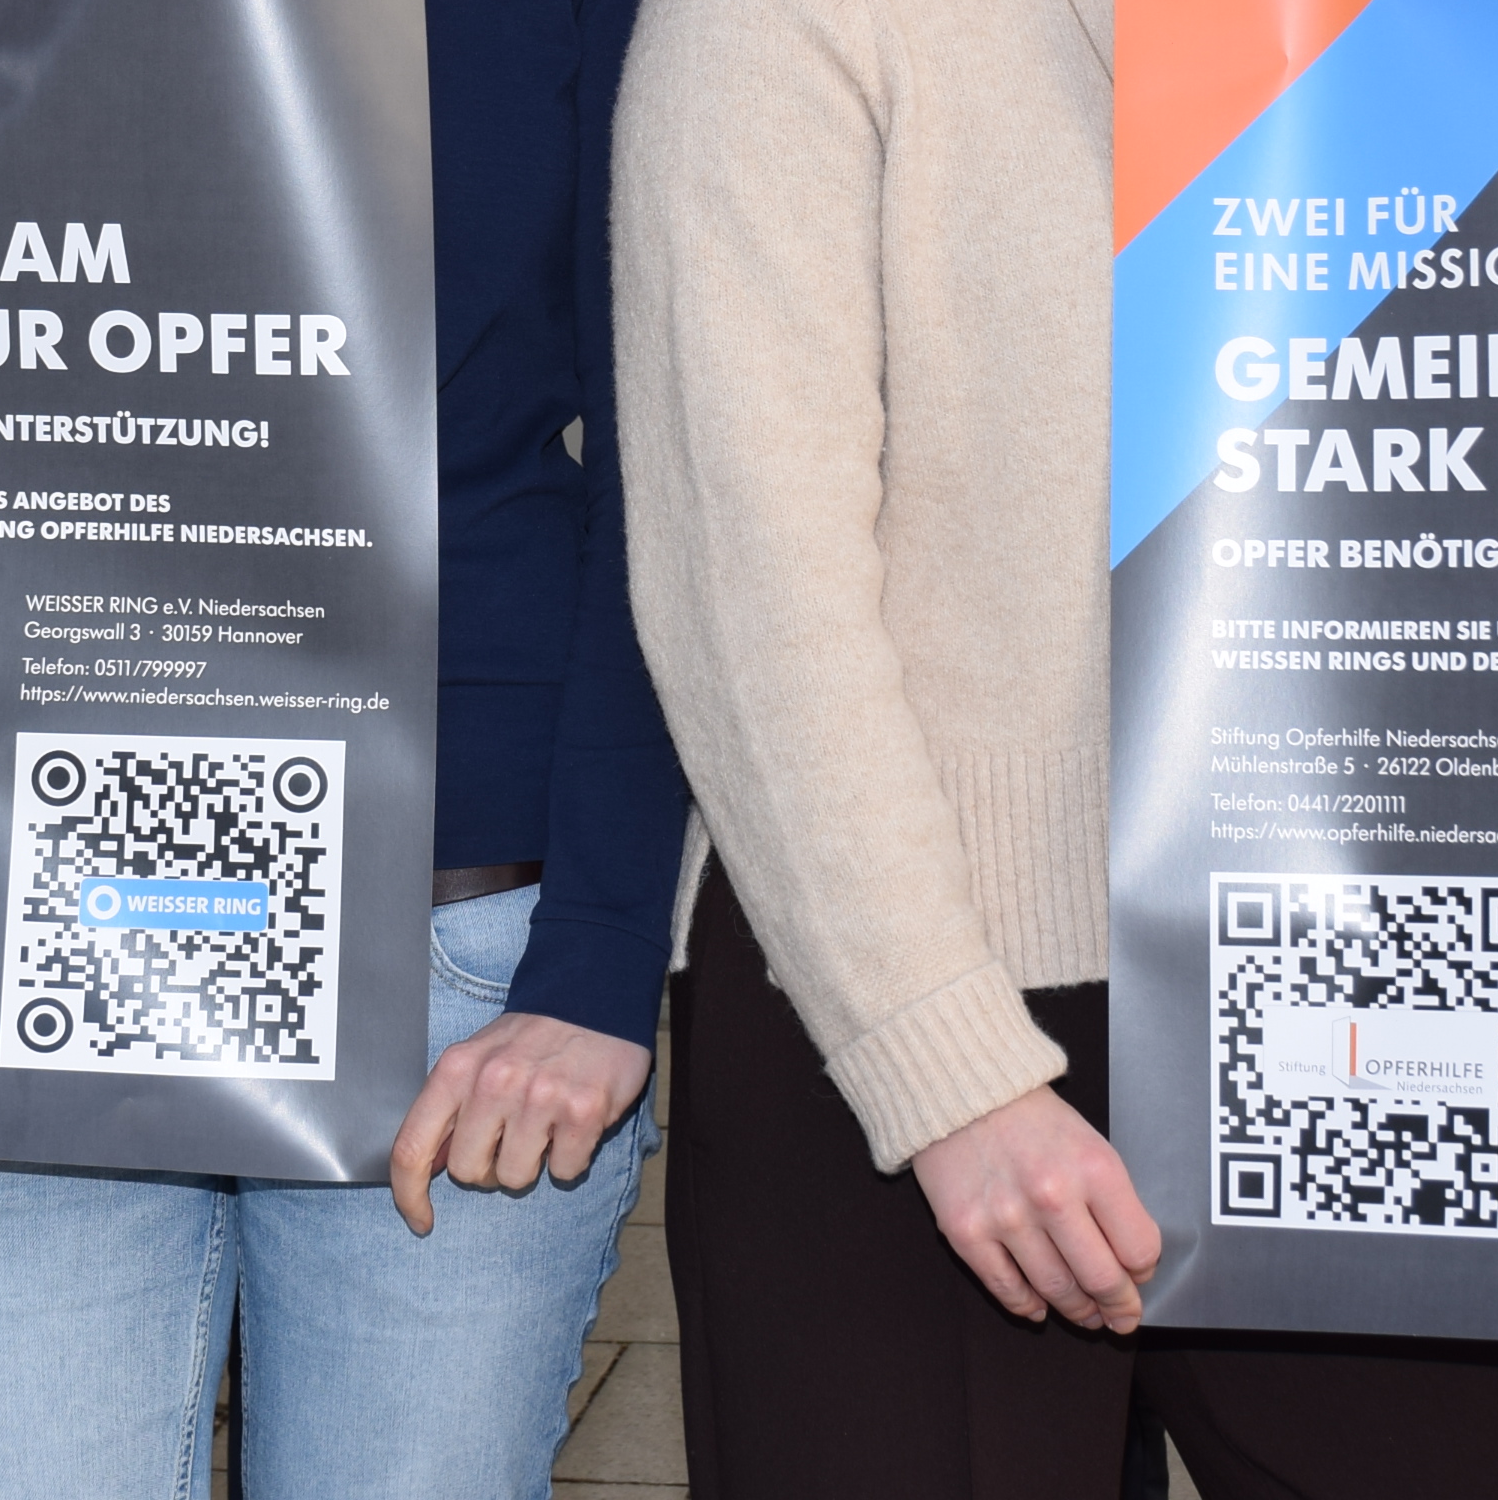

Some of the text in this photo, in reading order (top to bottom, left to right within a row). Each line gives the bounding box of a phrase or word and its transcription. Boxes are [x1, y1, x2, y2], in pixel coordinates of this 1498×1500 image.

[1213, 187, 1459, 236] ZWEI FÜR
[1216, 252, 1328, 290] EINE
[89, 310, 351, 375] OPFER
[1212, 427, 1486, 492] STARK
[13, 492, 124, 511] ANGEBOT
[130, 494, 170, 512] DES
[41, 521, 174, 541] OPFERHILFE
[181, 525, 372, 547] NIEDERSACHSEN.
[1211, 540, 1330, 568] OPFER
[26, 595, 324, 618] WEISSER RING e.V. Niedersachsen
[25, 621, 124, 643] Georgswall
[130, 624, 140, 640] 3
[162, 624, 212, 642] 30159
[219, 626, 303, 644] Hannover
[1213, 620, 1275, 639] BITTE
[1283, 621, 1450, 640] INFORMIEREN
[1457, 621, 1490, 640] SIE
[22, 657, 207, 678] Telefon: 0511/799997
[1211, 651, 1321, 670] WEISSEN
[1329, 651, 1406, 671] RINGS
[1412, 652, 1467, 671] UND
[21, 683, 389, 713] https://www.niedersachsen.weisser-ring.de
[1211, 727, 1279, 750] Stiftung
[1287, 728, 1380, 749] Opferhilfe
[1212, 755, 1338, 774] Mühlenstraße
[1344, 757, 1354, 775] 5
[1378, 757, 1430, 775] 26122
[1211, 793, 1405, 813] Telefon: 0441/2201111
[127, 896, 261, 915] WEISSER RING
[1278, 1061, 1327, 1076] Stiftung
[1365, 1059, 1484, 1079] OPFERHILFE
[1397, 1081, 1484, 1095] Niedersachsen
